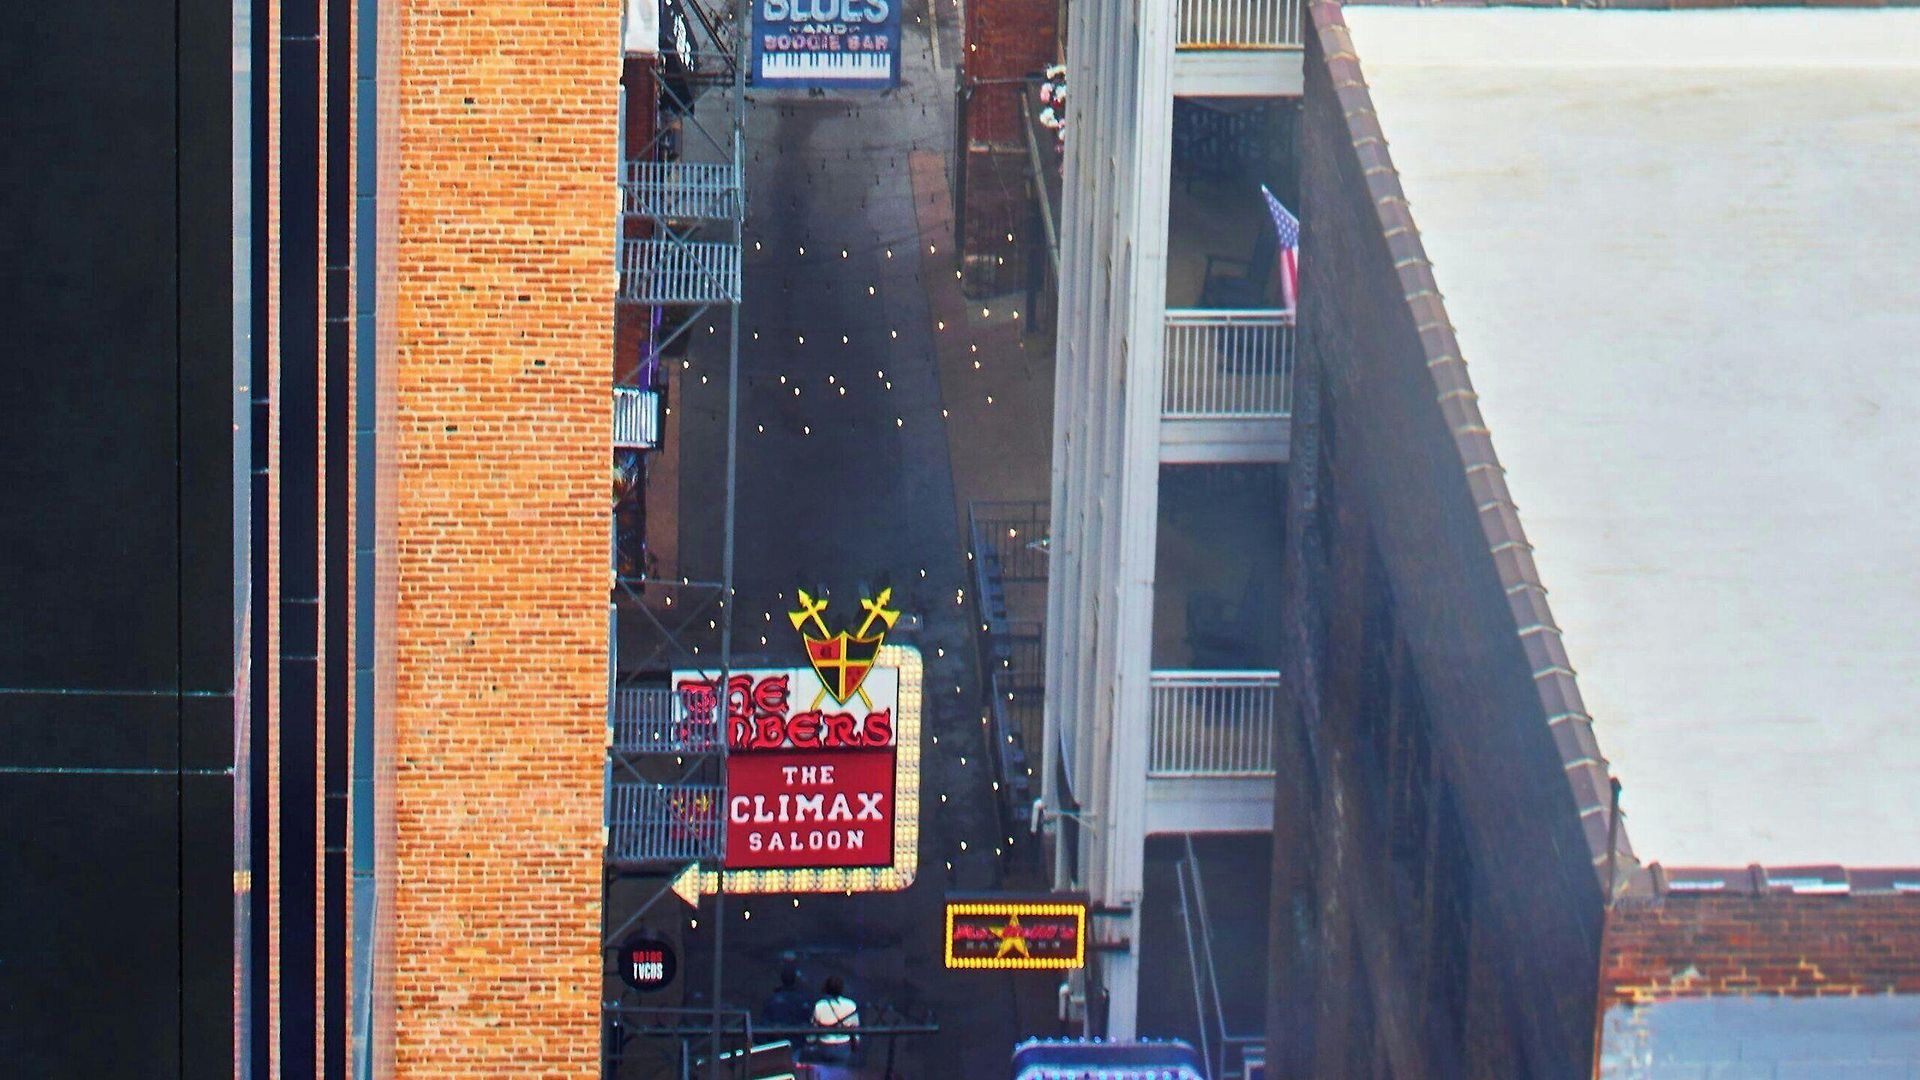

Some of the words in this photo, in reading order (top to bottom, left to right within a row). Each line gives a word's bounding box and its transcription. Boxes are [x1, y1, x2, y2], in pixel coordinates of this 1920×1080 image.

[763, 0, 890, 23] BLUES
[802, 24, 848, 34] AND
[764, 35, 840, 50] BOOGIE
[847, 35, 889, 50] BAR
[782, 765, 835, 785] THE
[730, 792, 884, 824] CLIMAX
[749, 829, 865, 852] SALOON
